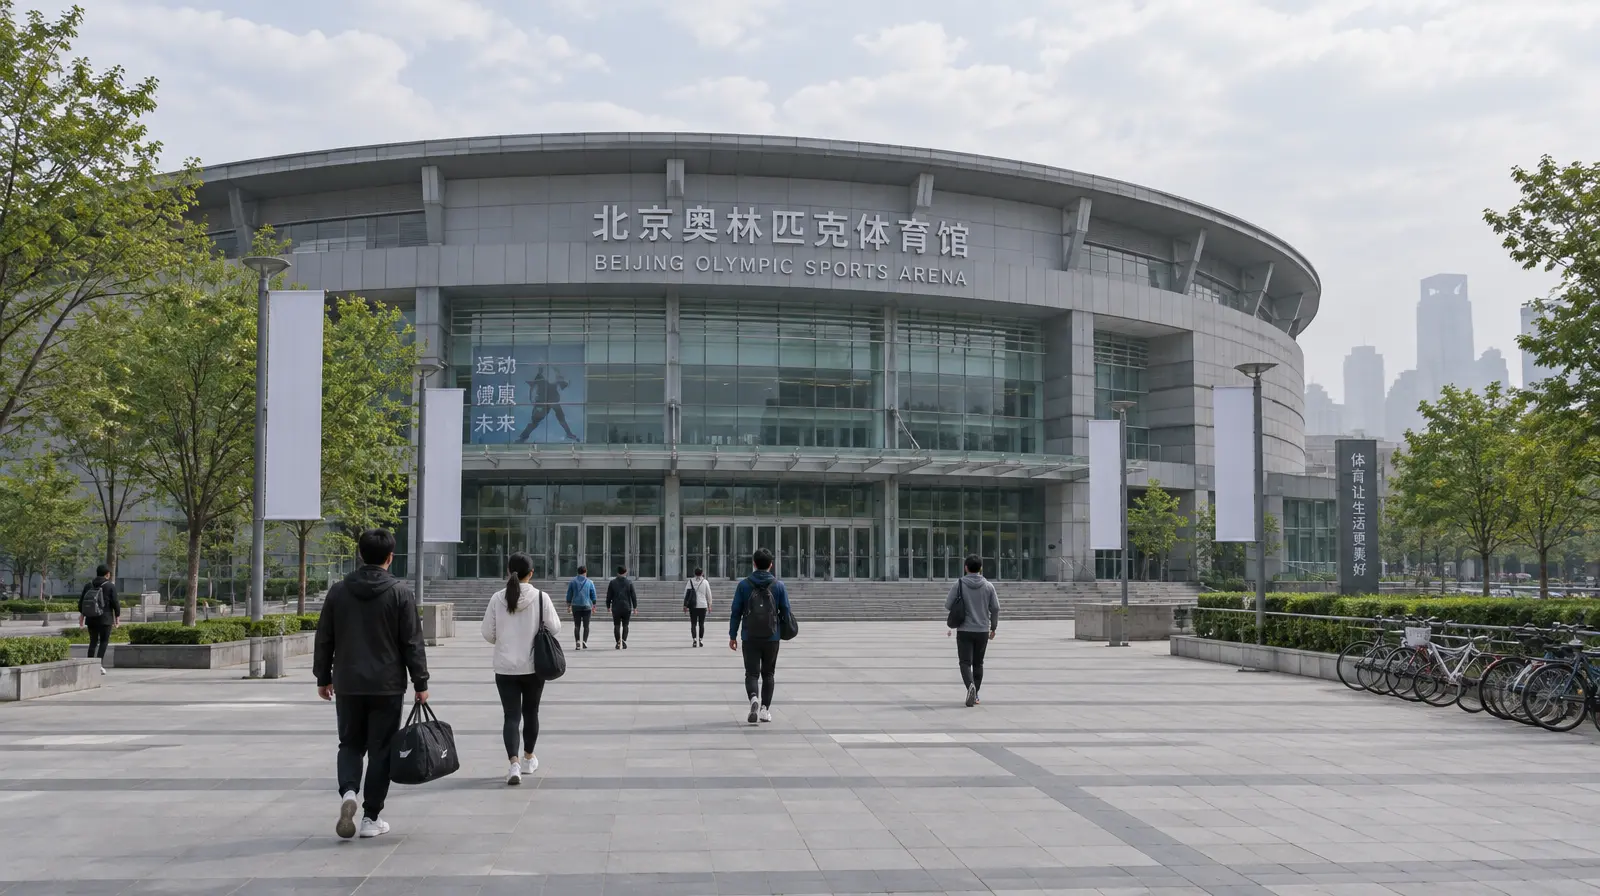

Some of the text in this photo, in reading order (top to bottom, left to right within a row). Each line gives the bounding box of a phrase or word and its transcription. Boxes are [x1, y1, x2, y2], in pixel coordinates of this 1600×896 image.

[592, 204, 970, 258] 北京奥林匹克体育馆
[595, 253, 968, 286] BEIJING OLYMPIC SPORTS ARENA
[475, 355, 517, 375] 运动
[474, 413, 516, 435] 未来
